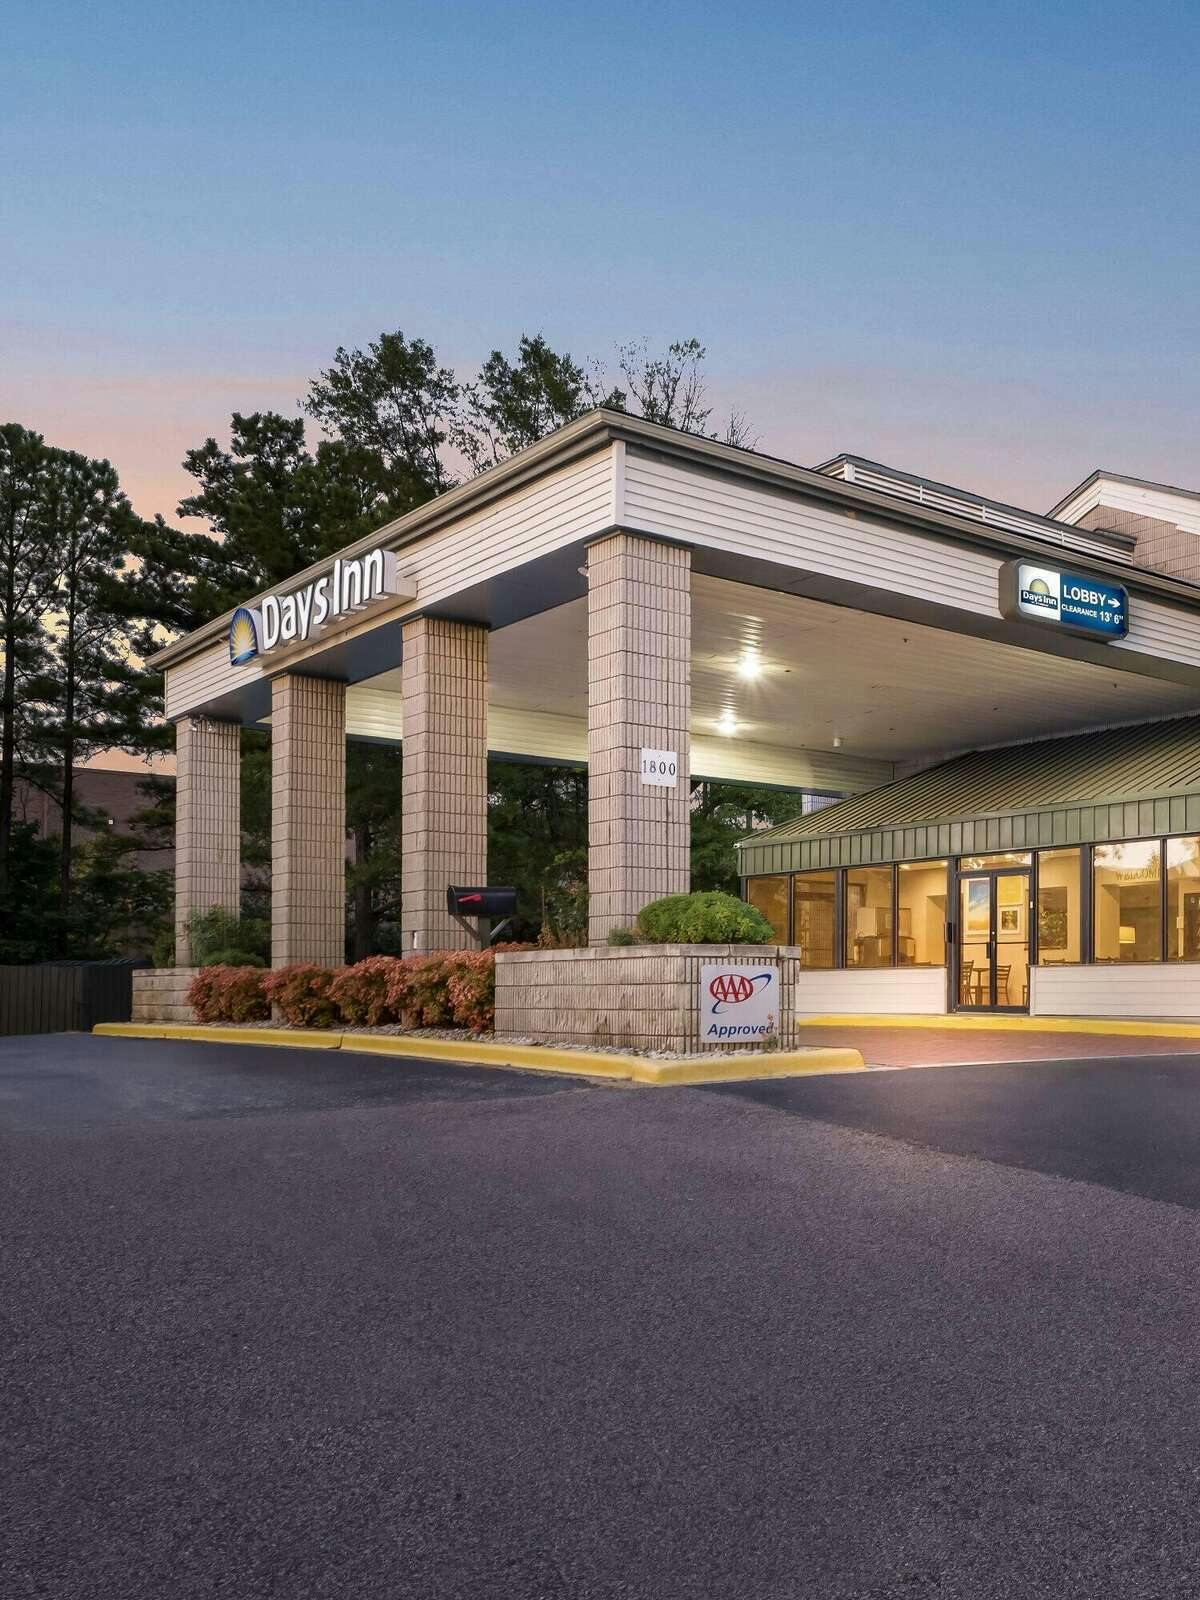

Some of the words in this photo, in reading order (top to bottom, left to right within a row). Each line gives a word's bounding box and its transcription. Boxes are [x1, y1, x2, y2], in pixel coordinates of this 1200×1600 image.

[262, 577, 330, 650] Days
[333, 549, 385, 616] Inn
[1023, 591, 1043, 603] Days
[1044, 595, 1057, 606] Inn
[1063, 584, 1107, 607] LOBBY
[1061, 603, 1098, 618] CLEARANCE
[643, 759, 676, 776] 1800
[713, 975, 750, 1002] AAA
[707, 1021, 775, 1038] Approved
